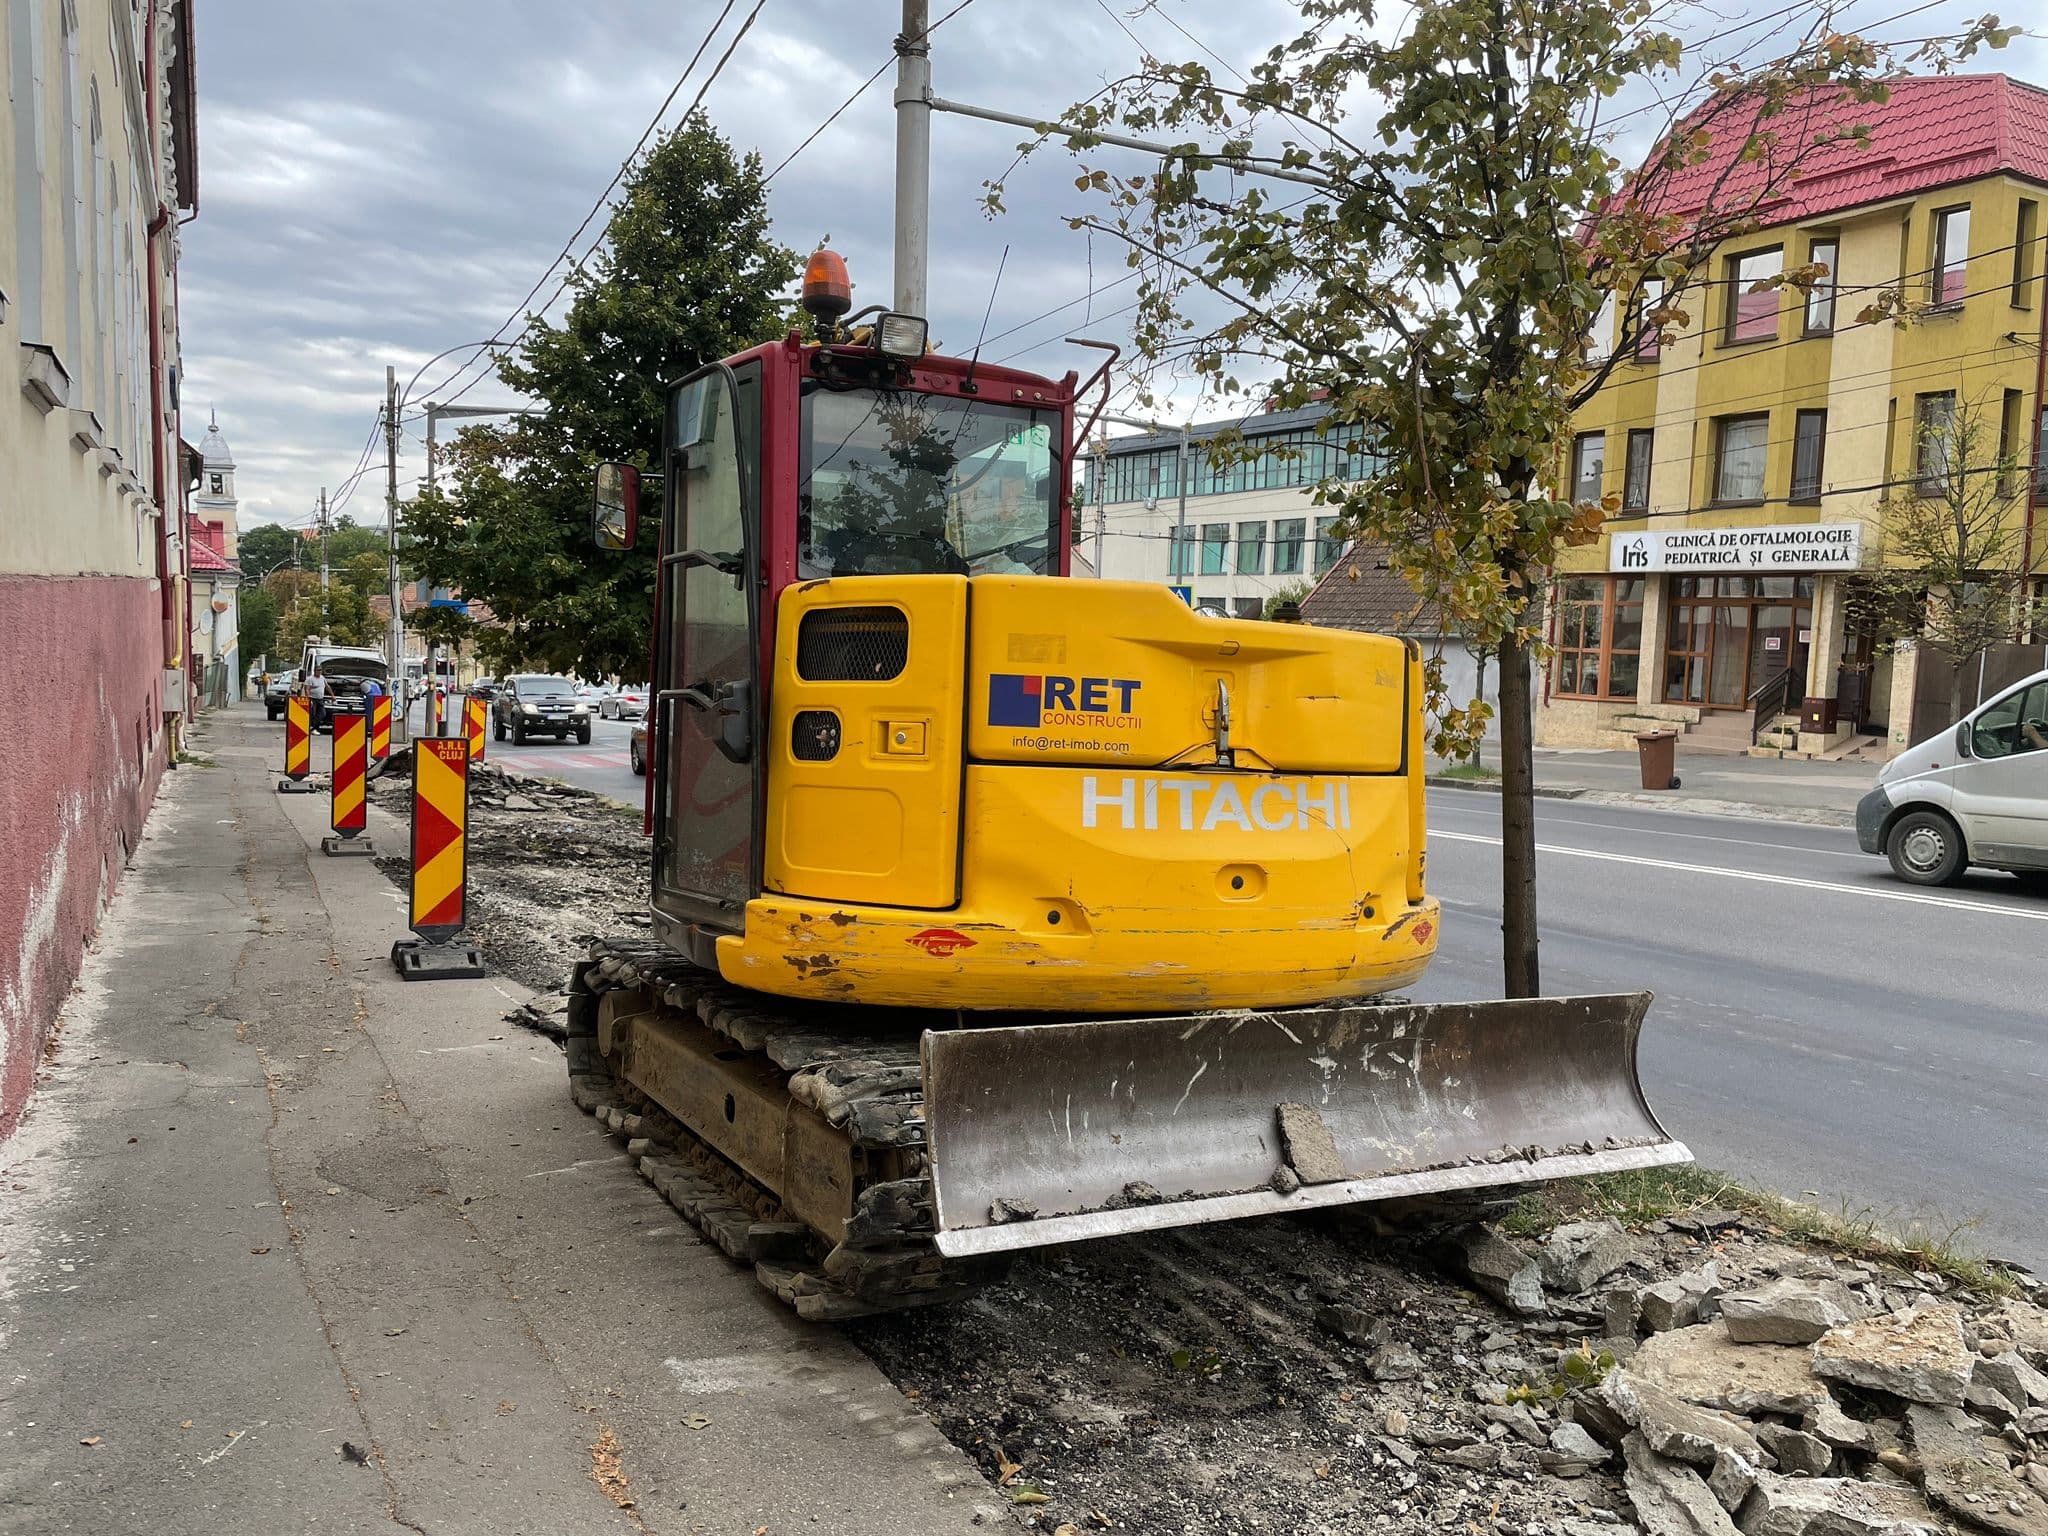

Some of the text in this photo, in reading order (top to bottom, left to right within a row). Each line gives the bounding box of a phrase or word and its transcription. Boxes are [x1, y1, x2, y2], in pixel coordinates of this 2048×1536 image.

[1665, 530, 1852, 548] CLINICĂ DE OFTALMOLOGIE
[1622, 545, 1648, 567] Iris
[1664, 547, 1850, 566] PEDIATRICĂ ȘI GENERALĂ
[1043, 676, 1142, 714] RET
[1043, 712, 1142, 729] CONSTRUCTII
[1012, 736, 1130, 752] info@ret-imob.com
[440, 750, 464, 760] CLUJ
[1082, 776, 1352, 831] HITACHI
